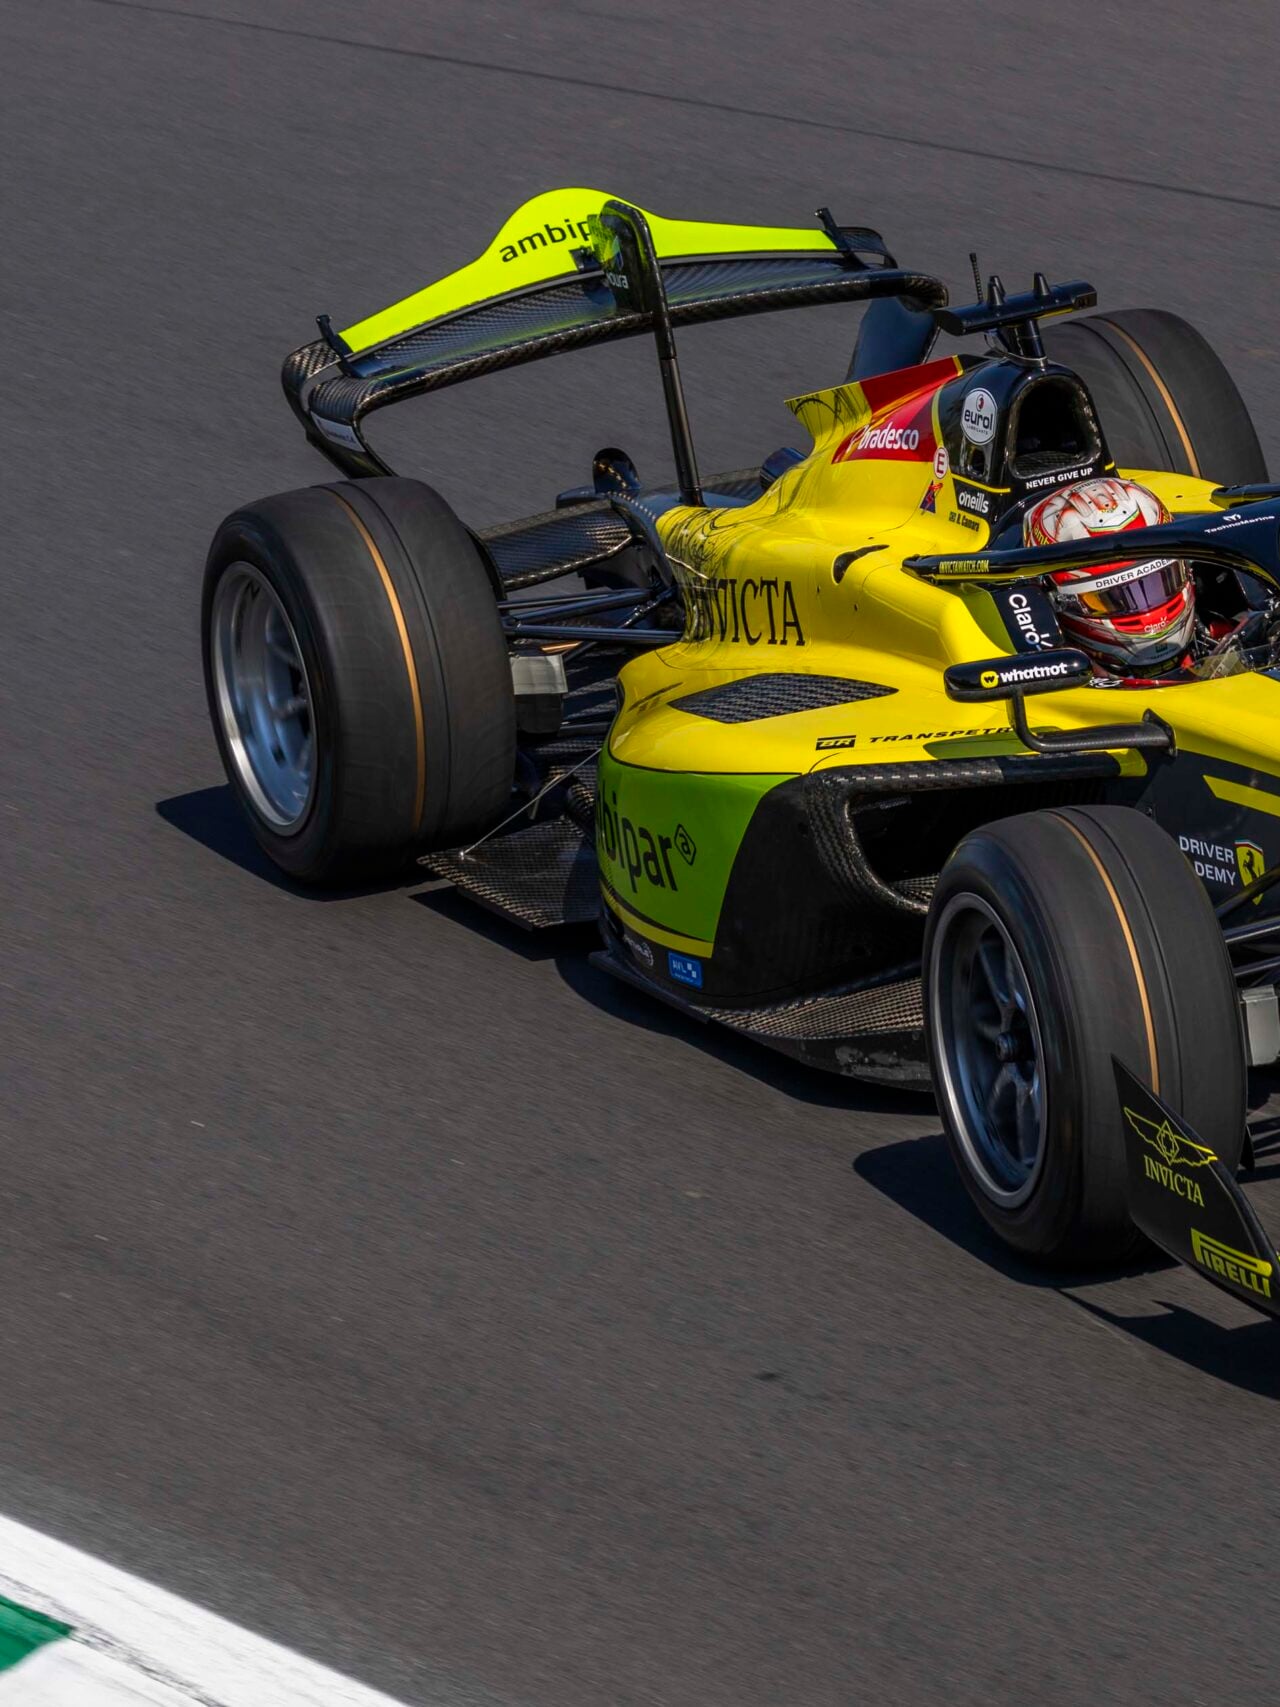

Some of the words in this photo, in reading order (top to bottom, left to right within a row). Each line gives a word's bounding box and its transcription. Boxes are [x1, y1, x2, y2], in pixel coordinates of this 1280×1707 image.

[499, 218, 592, 263] ambip
[964, 410, 993, 431] eurol
[936, 452, 945, 475] E
[1025, 477, 1057, 490] NEVER
[1057, 470, 1079, 483] GIVE
[1080, 467, 1094, 477] UP
[938, 559, 990, 574] INVICTAWATCH.COM
[1095, 571, 1136, 589] DRIVER
[1136, 558, 1171, 577] ACADE
[1008, 593, 1042, 646] Claro
[1000, 662, 1068, 684] whatnot
[600, 779, 678, 894] bipar
[1179, 835, 1235, 865] DRIVER
[1194, 860, 1236, 886] DEMY
[1143, 1154, 1205, 1208] INVICTA
[1190, 1227, 1273, 1298] PIRELLI
